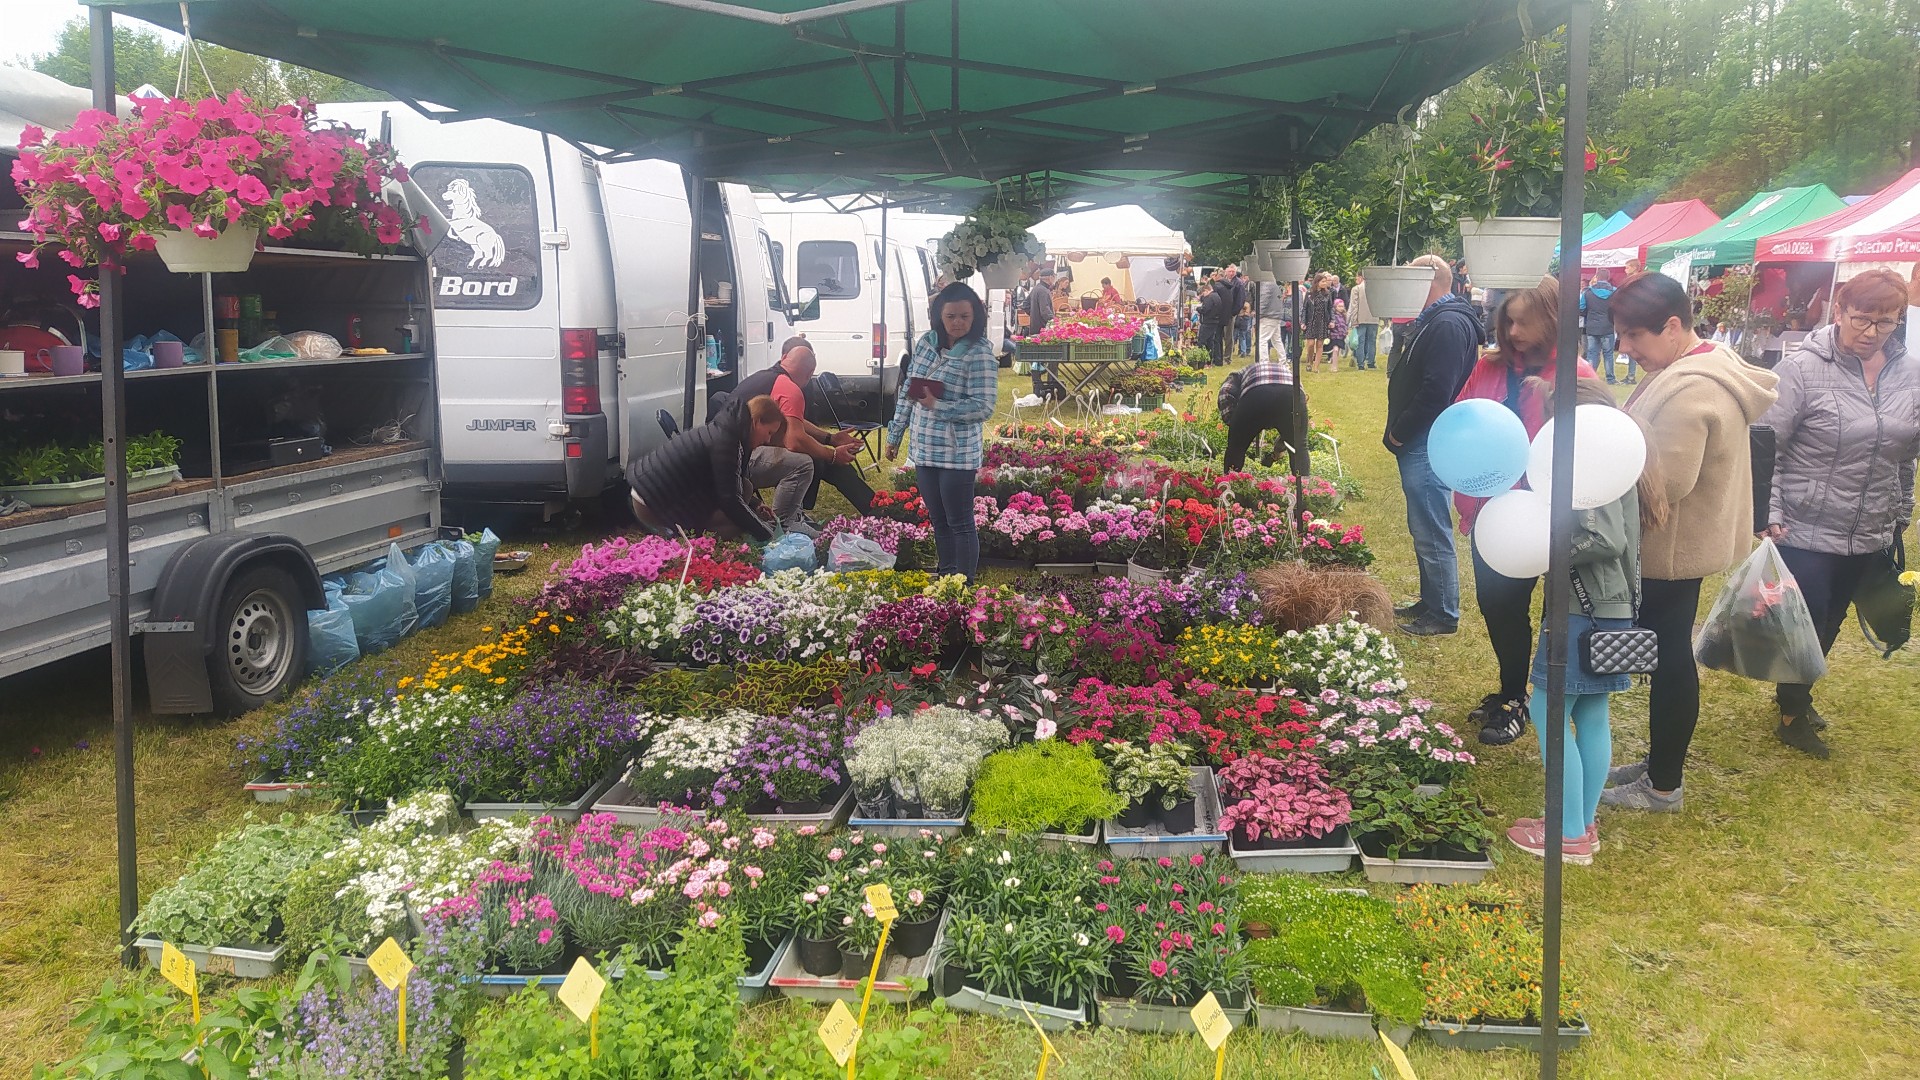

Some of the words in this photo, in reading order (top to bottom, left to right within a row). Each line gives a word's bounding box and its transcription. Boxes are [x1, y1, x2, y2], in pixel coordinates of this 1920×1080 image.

[439, 276, 518, 296] Bord
[466, 419, 536, 431] JUMPER
[1573, 578, 1588, 603] YOUNG
